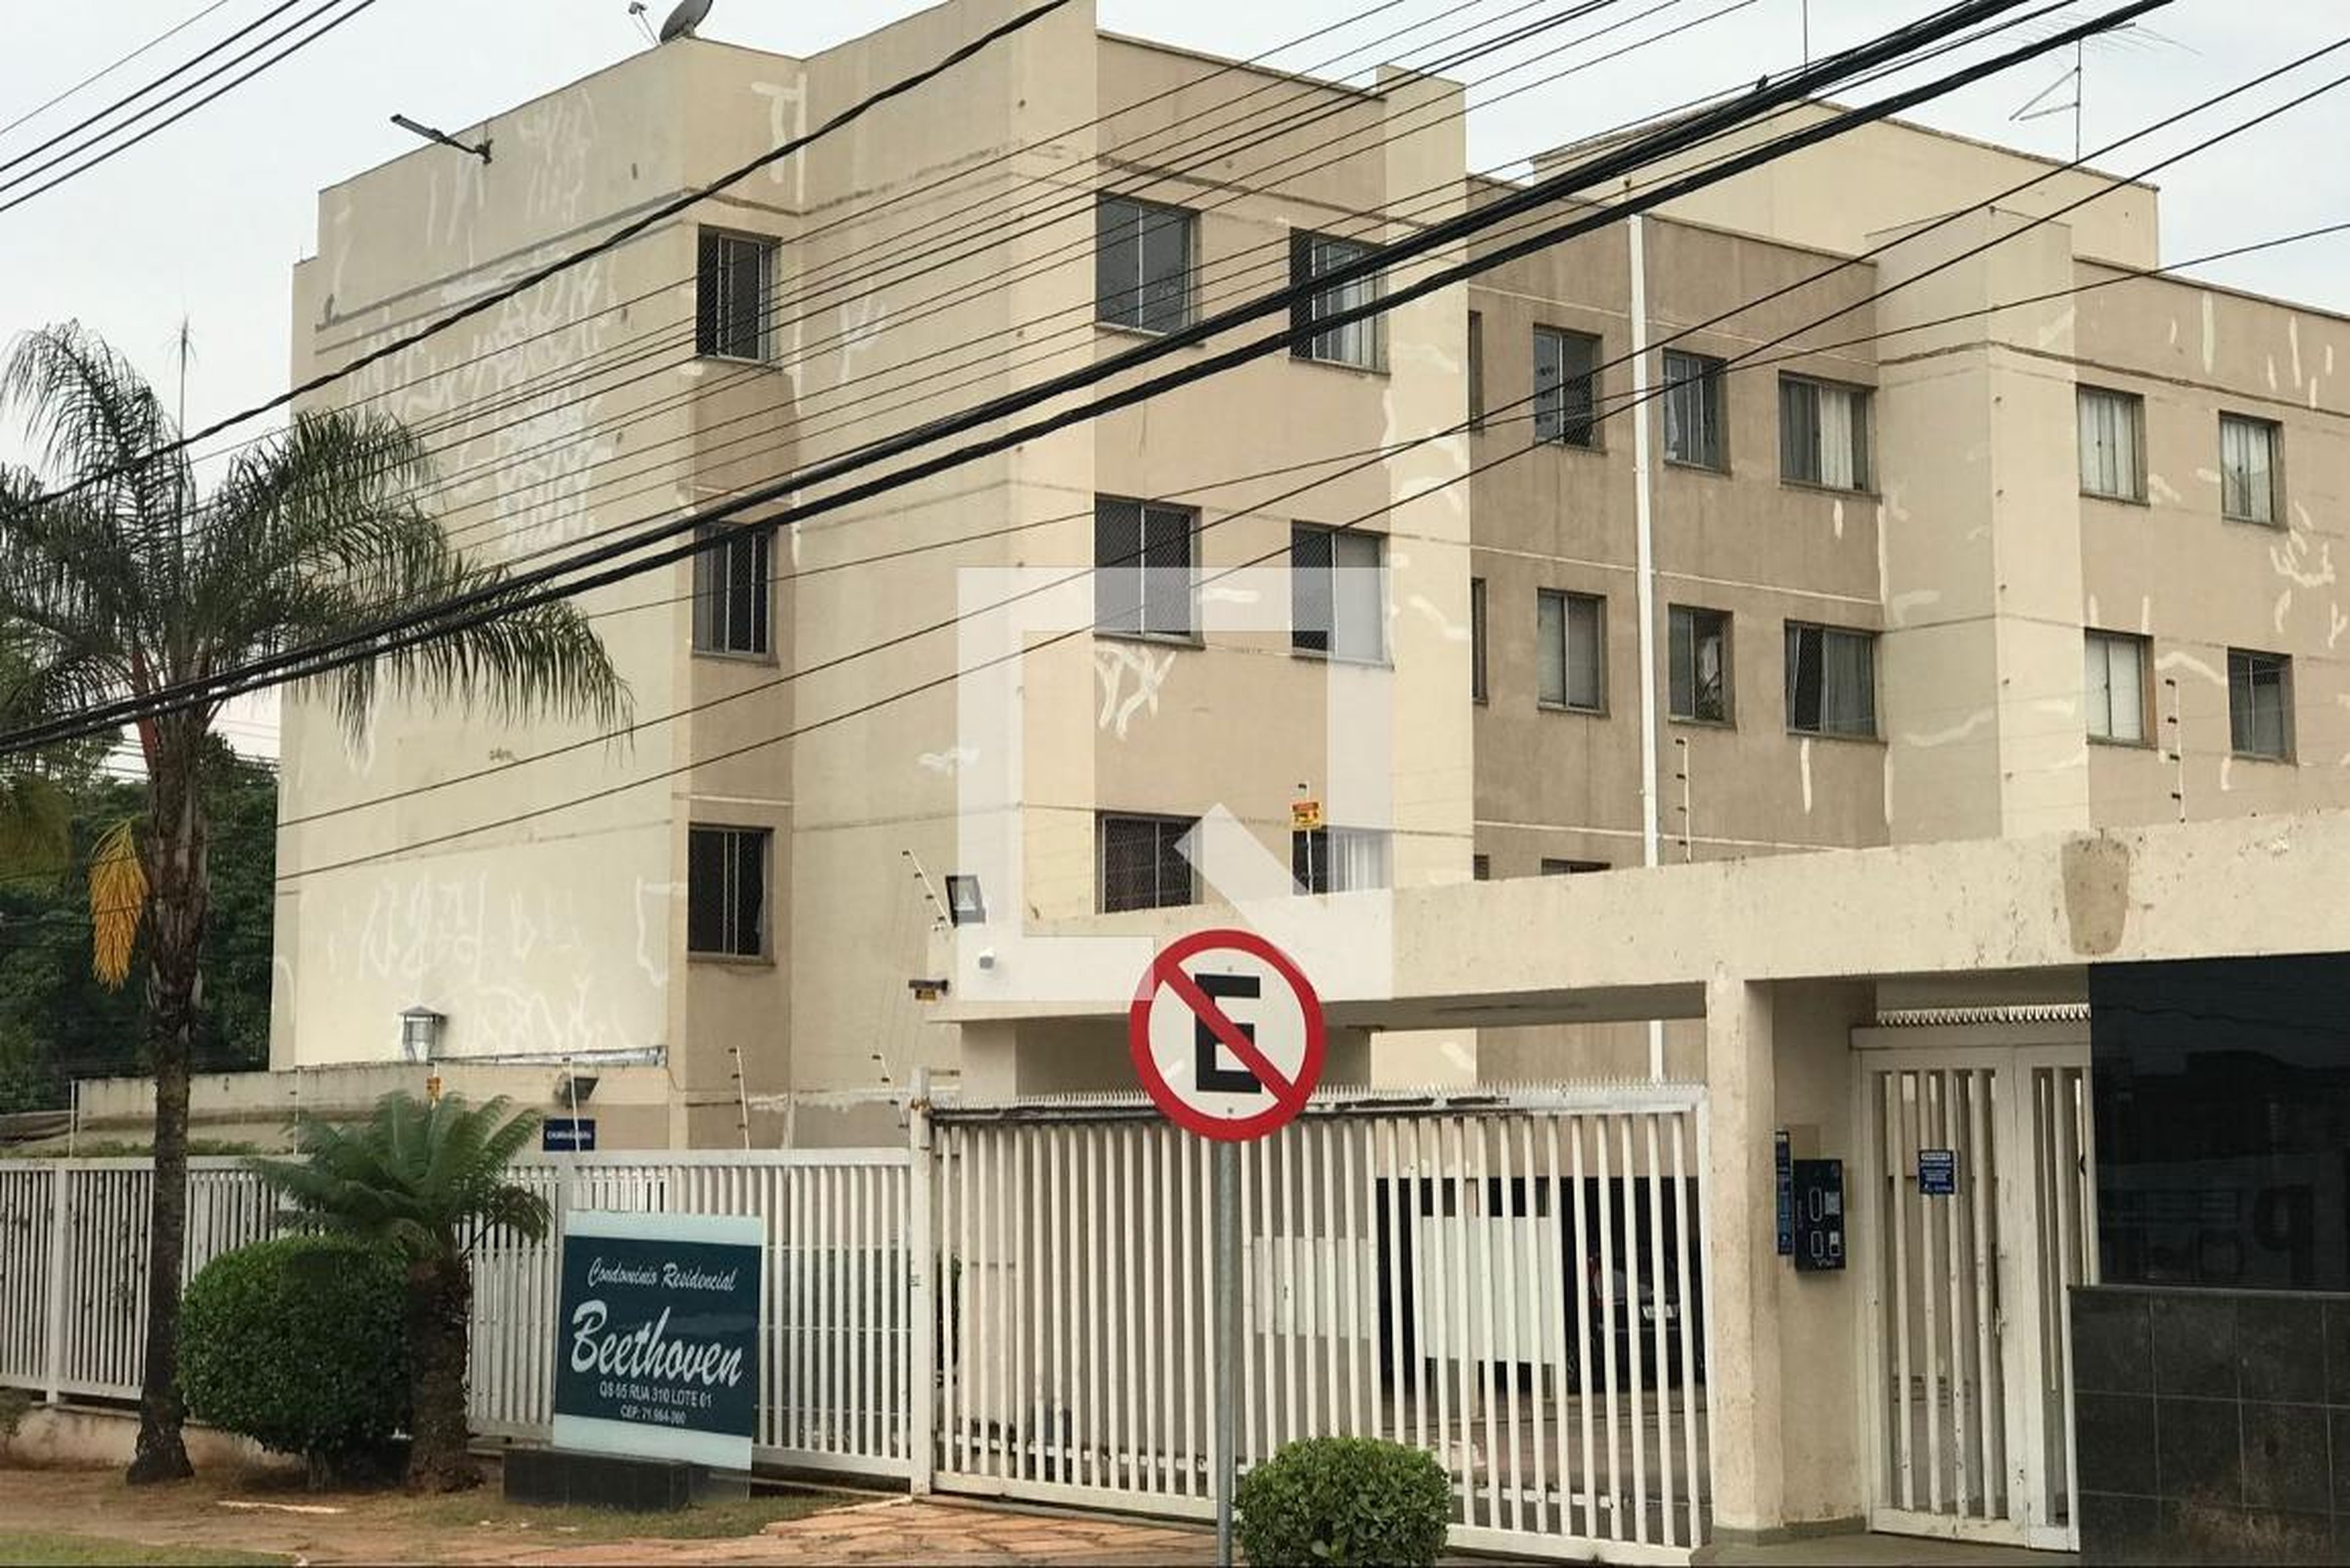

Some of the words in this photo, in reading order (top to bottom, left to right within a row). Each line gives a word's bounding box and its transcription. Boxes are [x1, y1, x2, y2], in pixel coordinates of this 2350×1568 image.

[1194, 973, 1262, 1094] E
[661, 1263, 737, 1291] Residencial
[571, 1299, 742, 1387] Beethoven
[629, 1384, 650, 1403] RUA
[652, 1387, 670, 1403] 310
[672, 1389, 698, 1407] LOTE
[699, 1392, 712, 1408] 01
